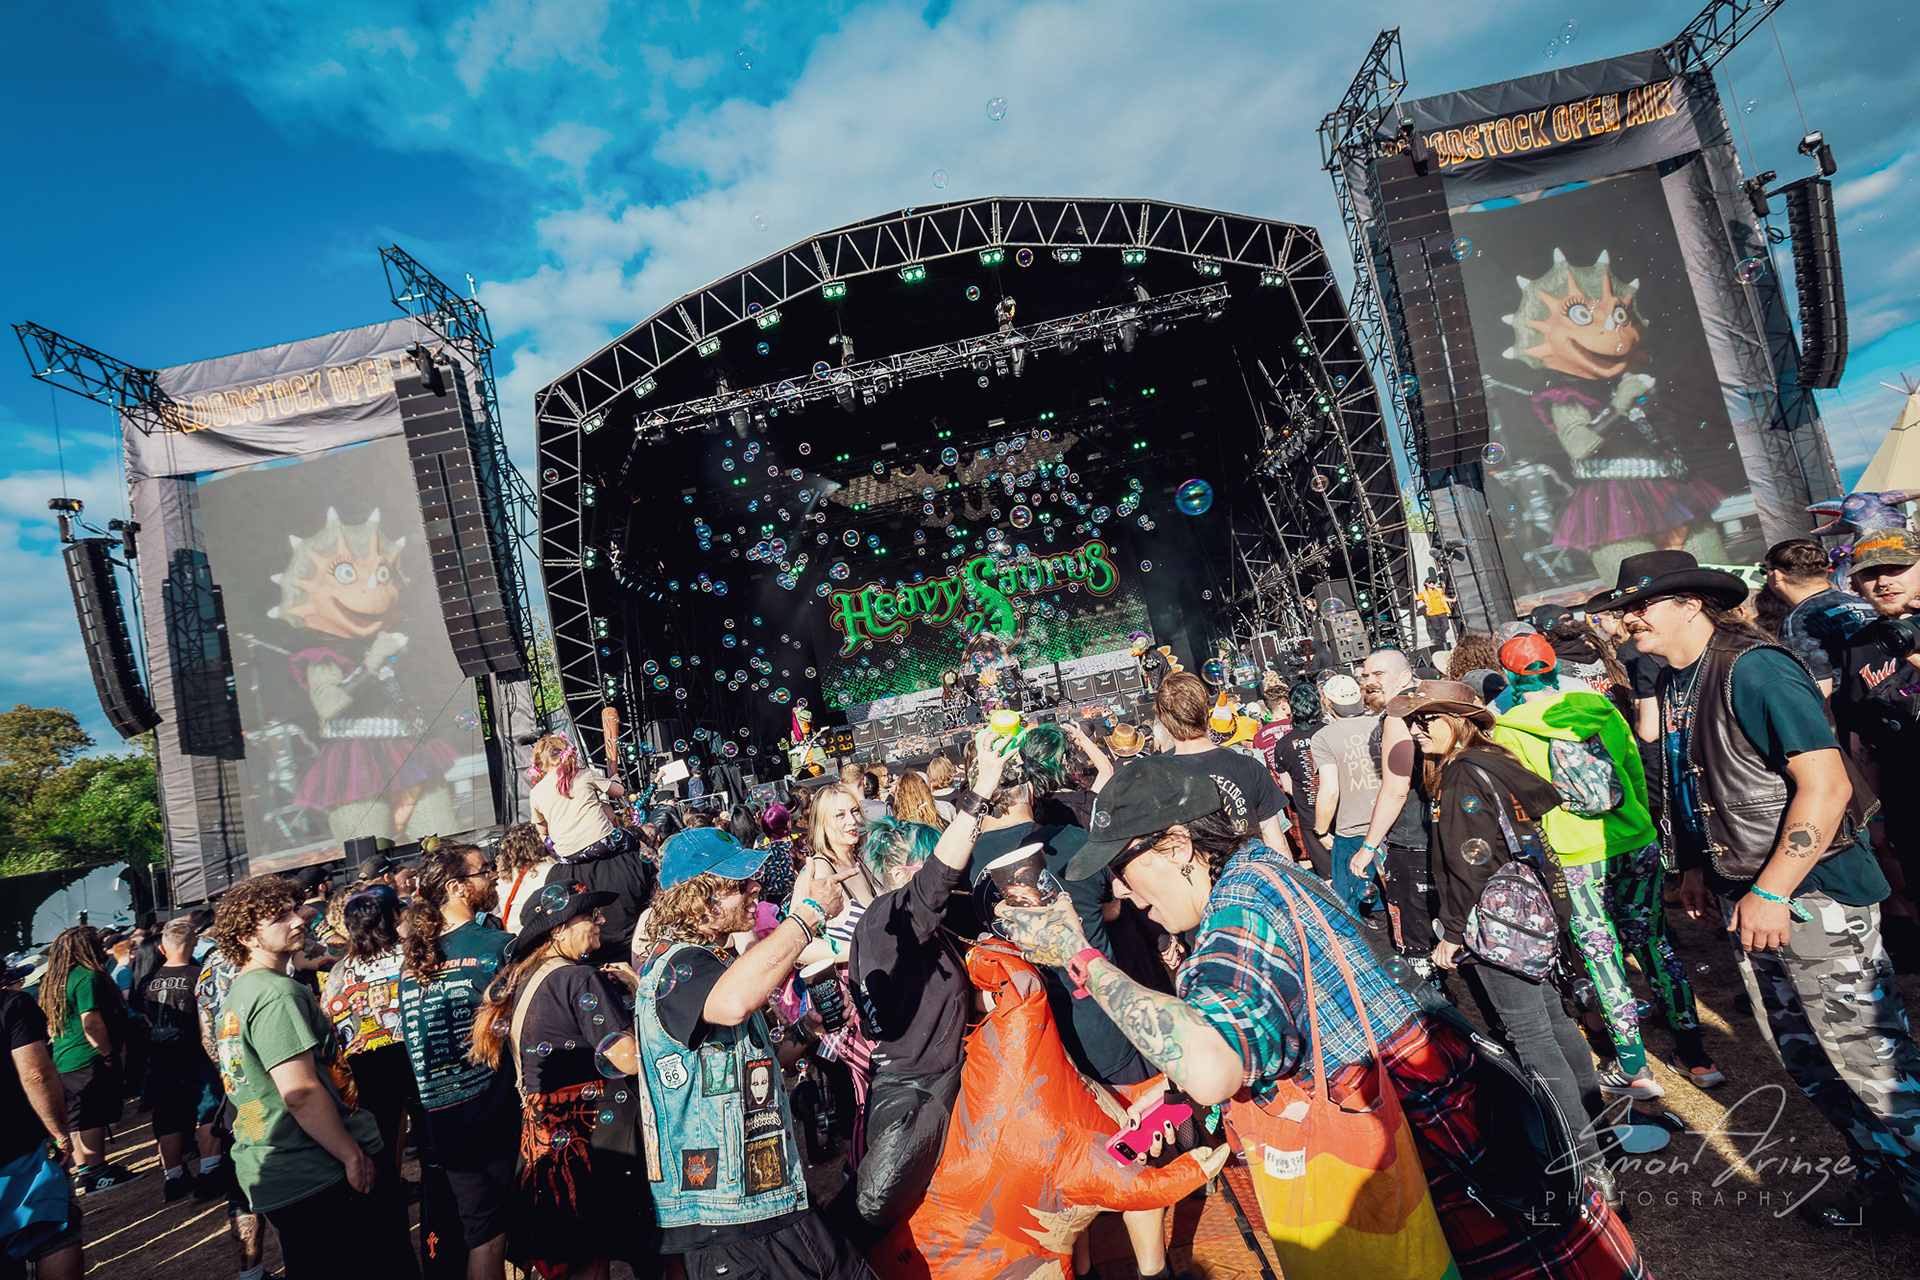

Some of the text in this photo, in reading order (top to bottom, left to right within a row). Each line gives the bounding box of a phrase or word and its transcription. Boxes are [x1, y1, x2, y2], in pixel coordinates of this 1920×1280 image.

[1552, 93, 1620, 142] OPEN
[1626, 80, 1678, 127] AIR
[326, 357, 396, 403] OPEN
[440, 957, 478, 970] OPEN AIR
[664, 1069, 680, 1082] 66
